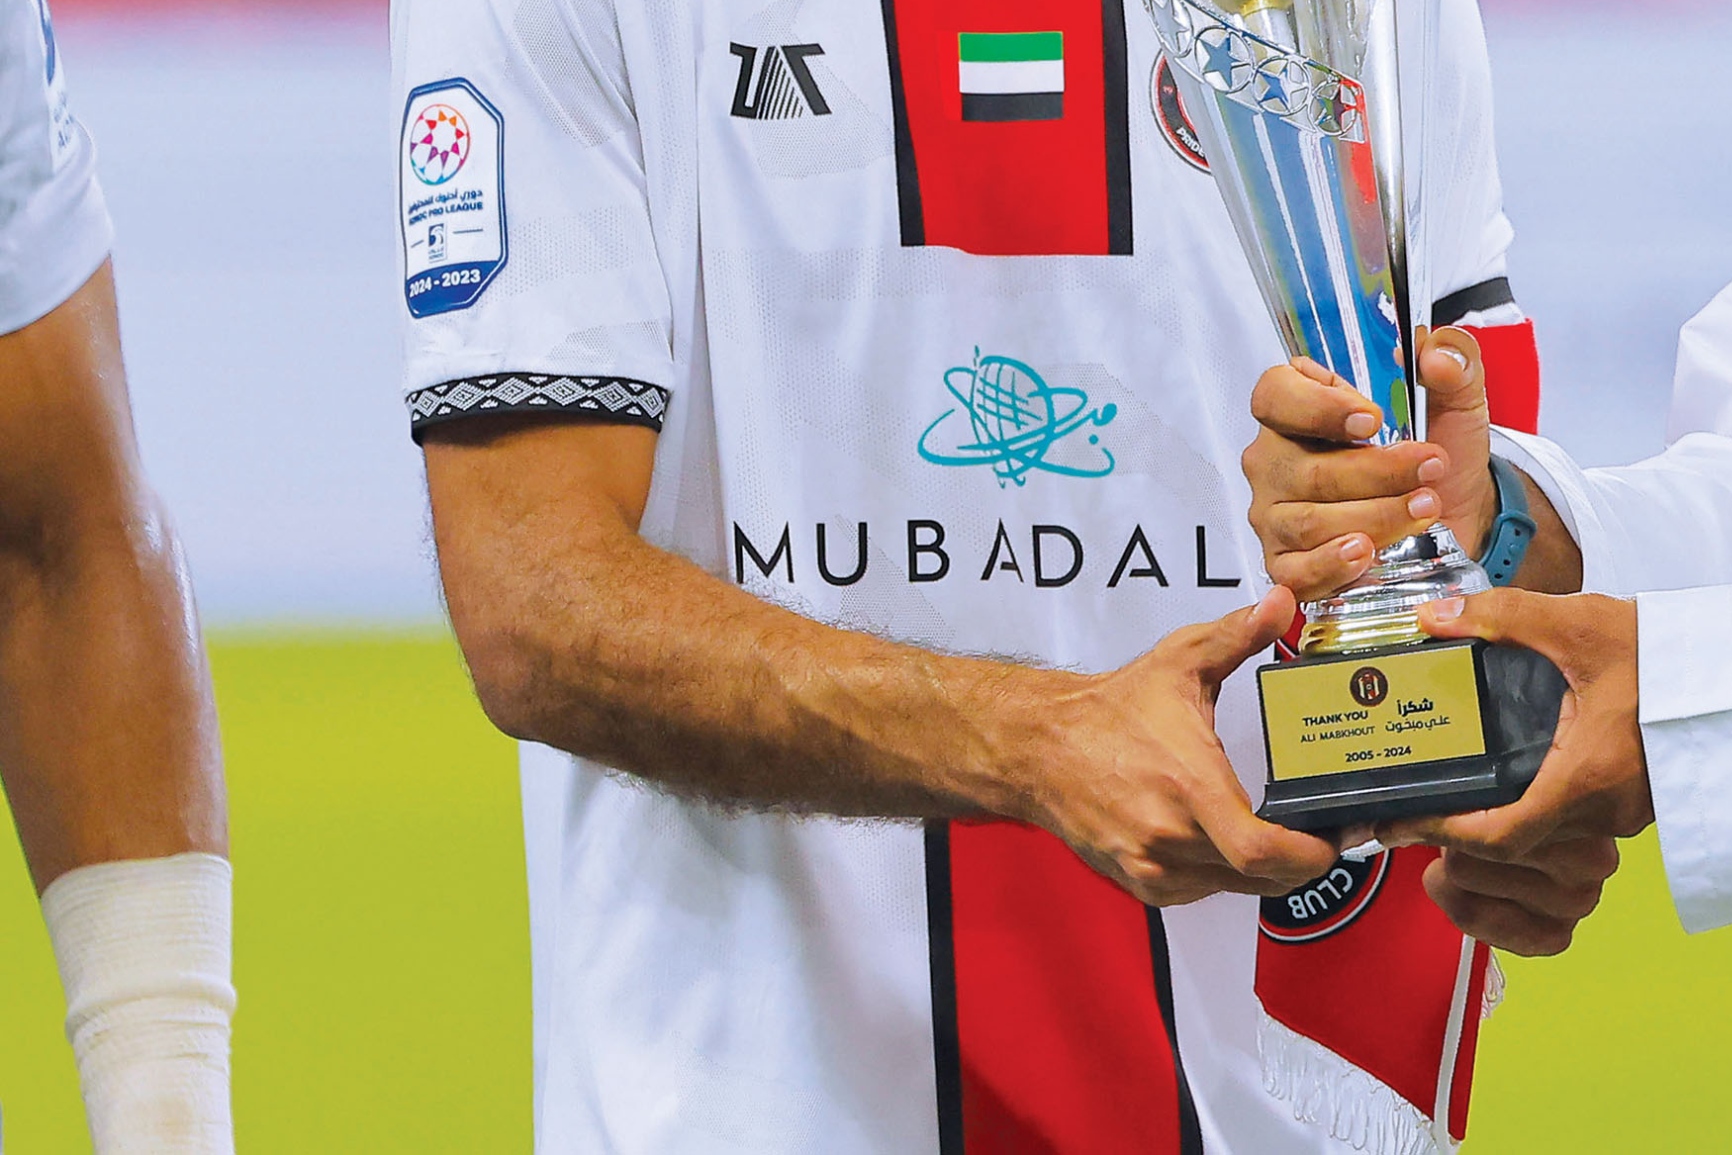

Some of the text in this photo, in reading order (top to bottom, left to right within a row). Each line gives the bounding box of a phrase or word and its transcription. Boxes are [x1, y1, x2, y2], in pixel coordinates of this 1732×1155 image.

[409, 277, 432, 298] 2024
[441, 269, 481, 287] 2023
[733, 518, 1242, 589] MUBADAL
[1302, 710, 1368, 727] THANK YOU
[1300, 726, 1375, 743] ALI MABKHOUT
[1345, 749, 1374, 762] 2005
[1384, 745, 1411, 757] 2024
[1287, 867, 1353, 919] CLUB
